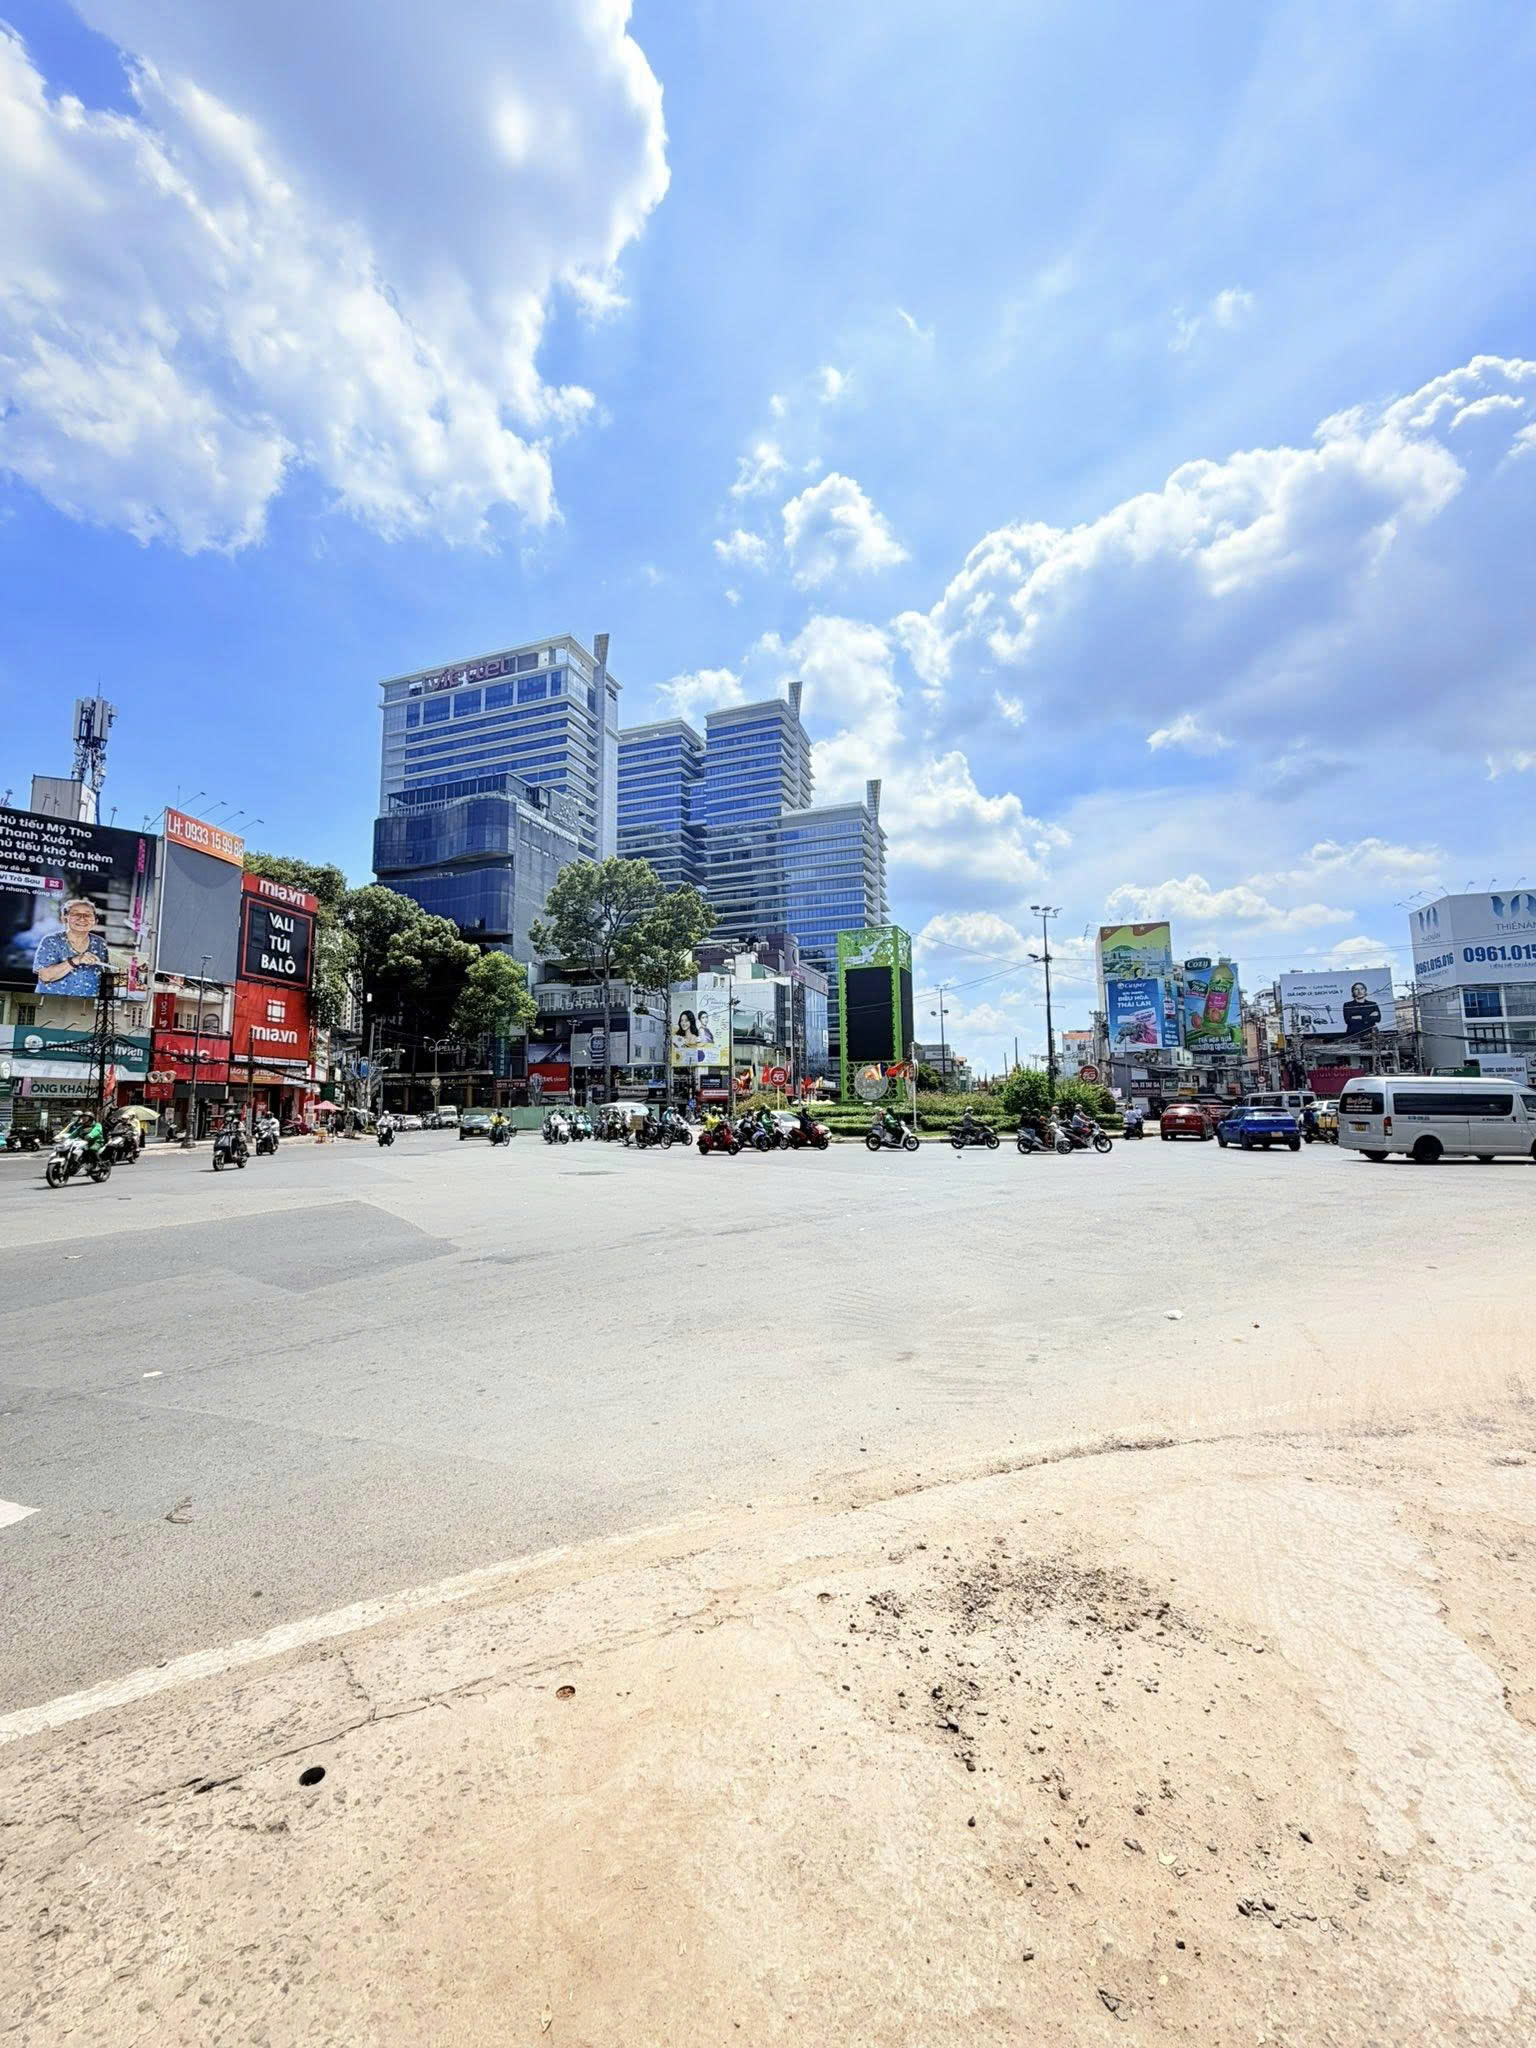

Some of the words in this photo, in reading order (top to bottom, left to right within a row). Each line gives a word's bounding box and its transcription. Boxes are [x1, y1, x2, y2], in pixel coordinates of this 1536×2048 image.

[0, 826, 38, 840] Thanh
[41, 833, 73, 846] Xuân
[19, 818, 44, 830] tiếu
[47, 822, 66, 835] Mỹ
[69, 826, 92, 838] Tho
[168, 814, 183, 836] LH:
[184, 821, 209, 845] 0933
[16, 840, 40, 852] tiếu
[43, 845, 67, 856] khô
[69, 849, 85, 859] ăn
[87, 851, 113, 864] kèm
[67, 861, 99, 872] danh
[24, 877, 41, 885] Sau
[269, 912, 294, 933] VALI
[268, 934, 291, 954] TÚI
[261, 953, 296, 975] BALÔ
[1187, 960, 1209, 969] Cozy
[250, 1024, 298, 1044] mia.vn
